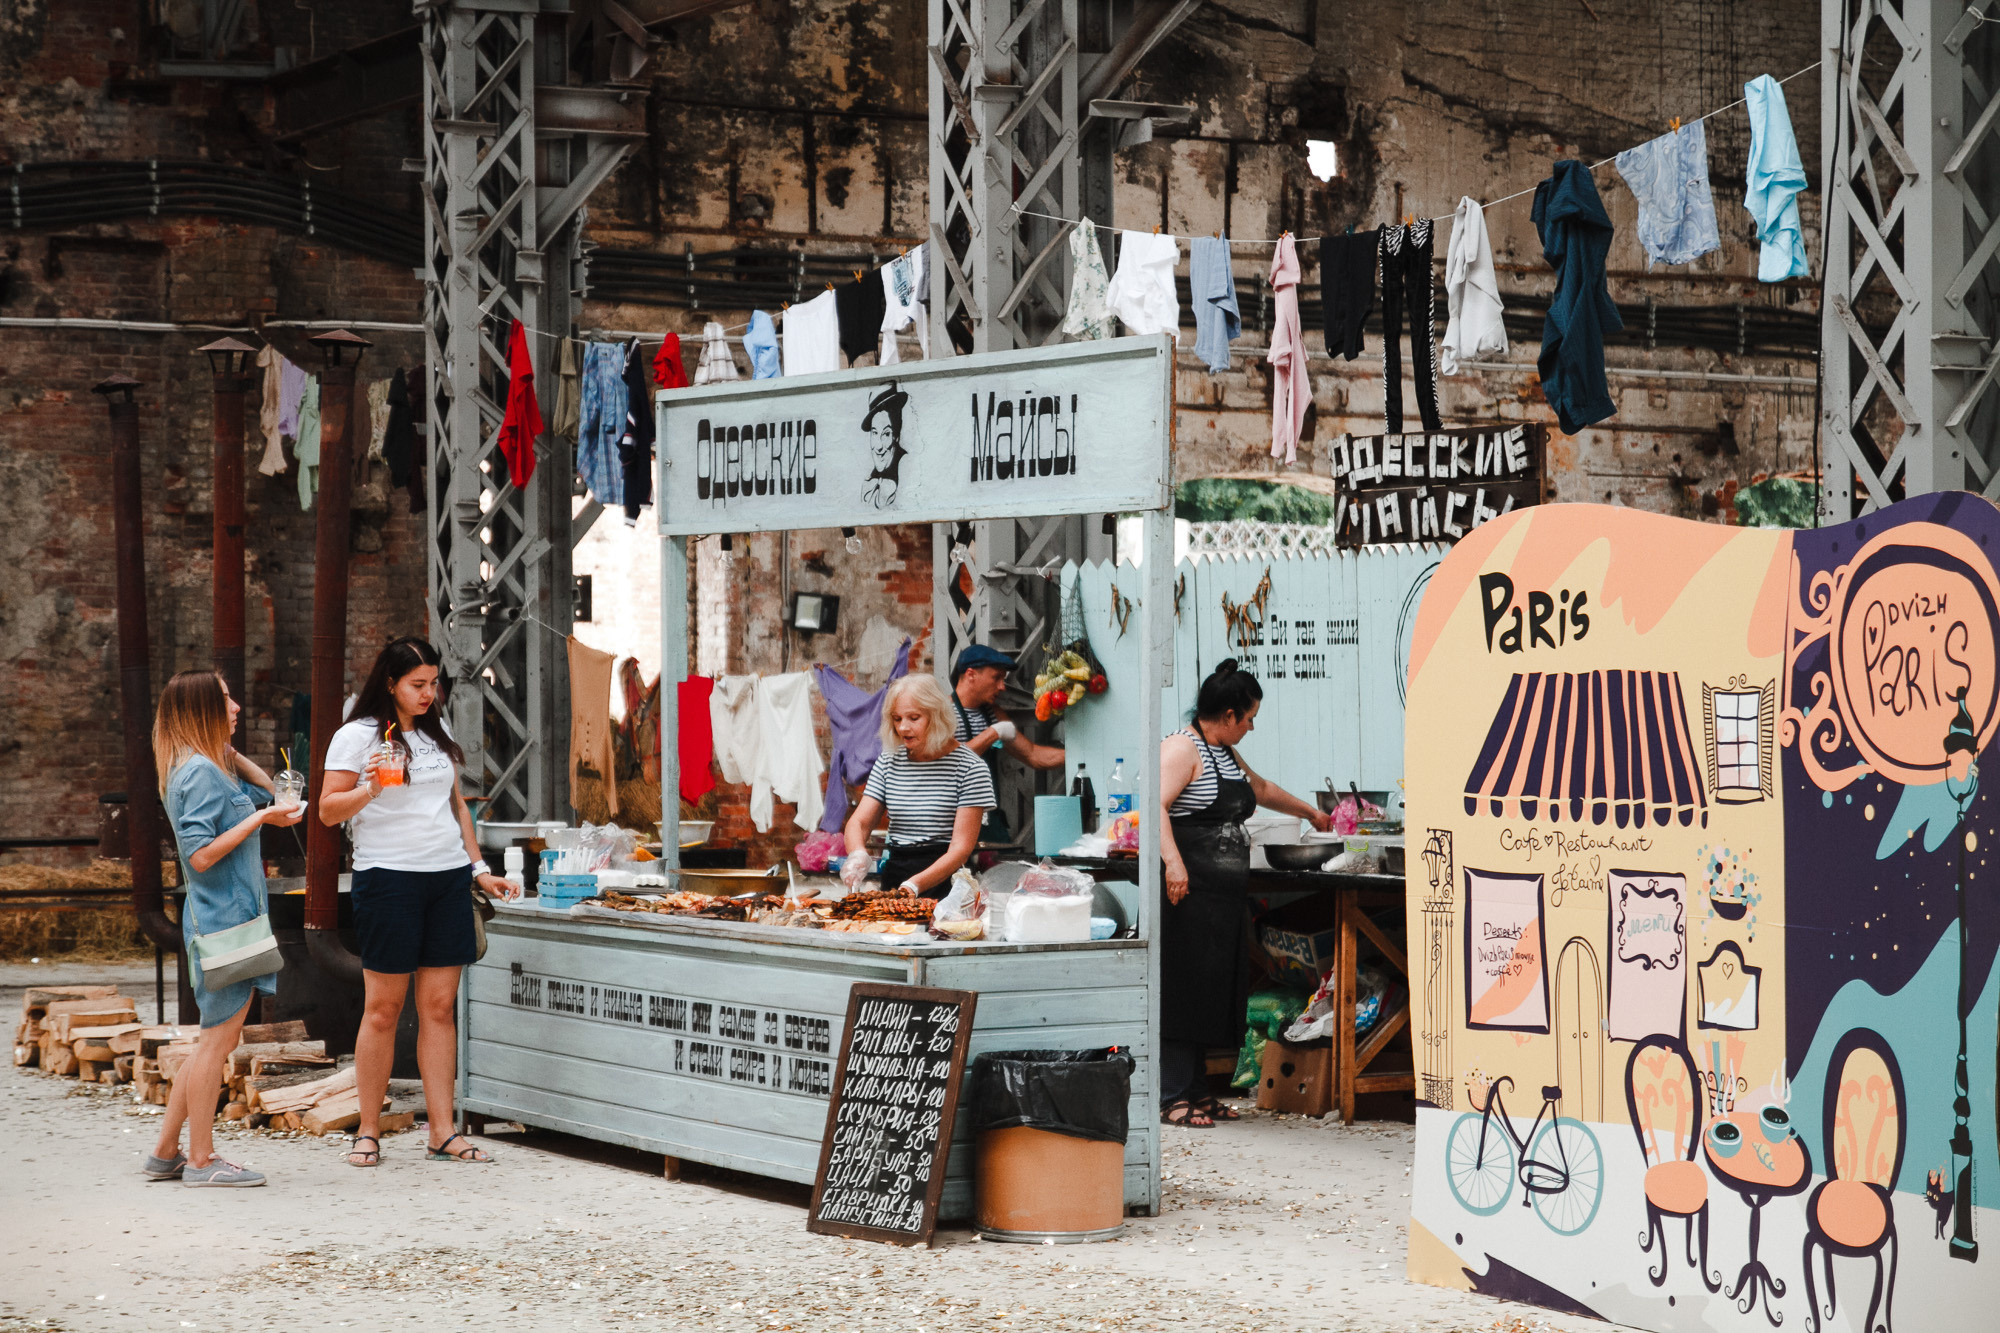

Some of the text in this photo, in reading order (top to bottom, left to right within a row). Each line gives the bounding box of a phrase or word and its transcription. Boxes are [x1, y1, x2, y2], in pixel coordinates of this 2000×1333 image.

[697, 390, 1078, 509] Одесские Майсы
[1328, 424, 1528, 491] ОДЕССКИЕ
[1499, 827, 1543, 862] Cafe
